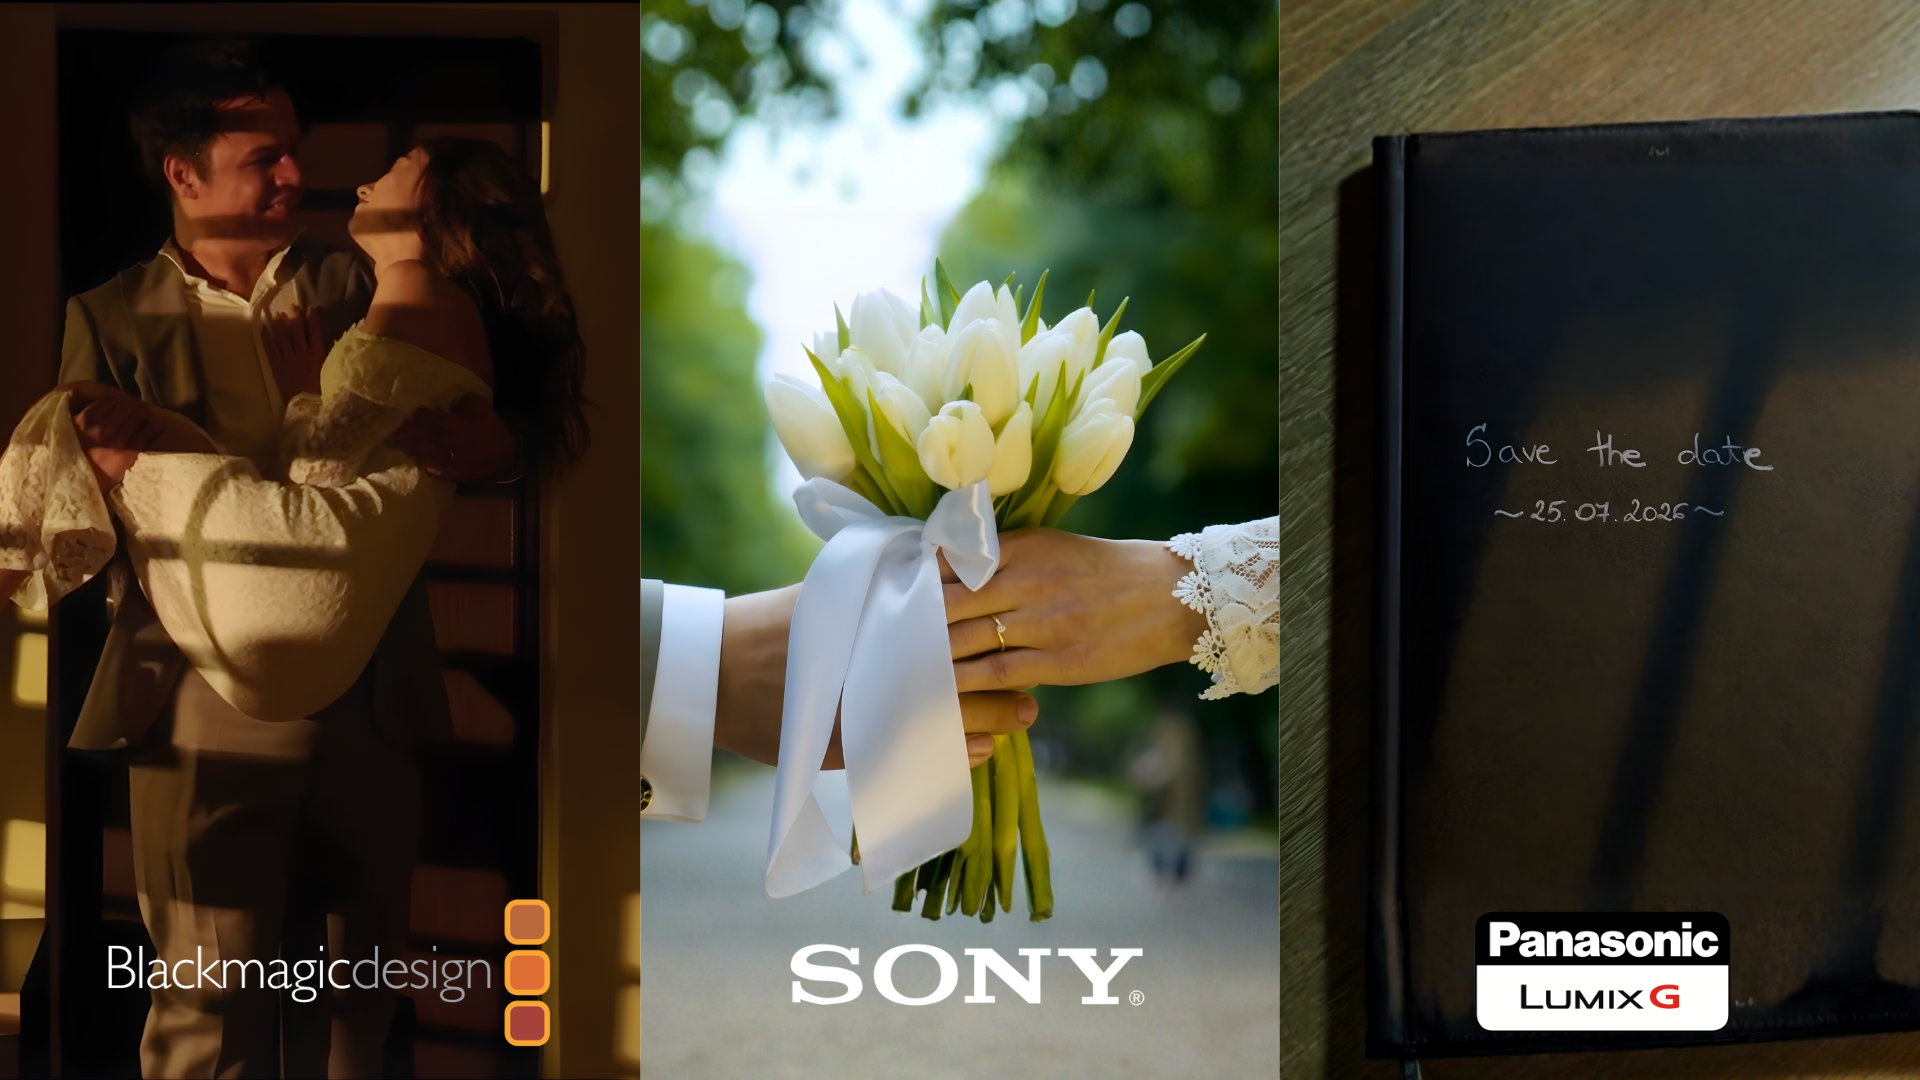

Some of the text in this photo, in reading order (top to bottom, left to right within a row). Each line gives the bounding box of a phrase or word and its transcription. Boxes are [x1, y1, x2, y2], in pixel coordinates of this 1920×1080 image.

[1466, 422, 1775, 472] Save the date
